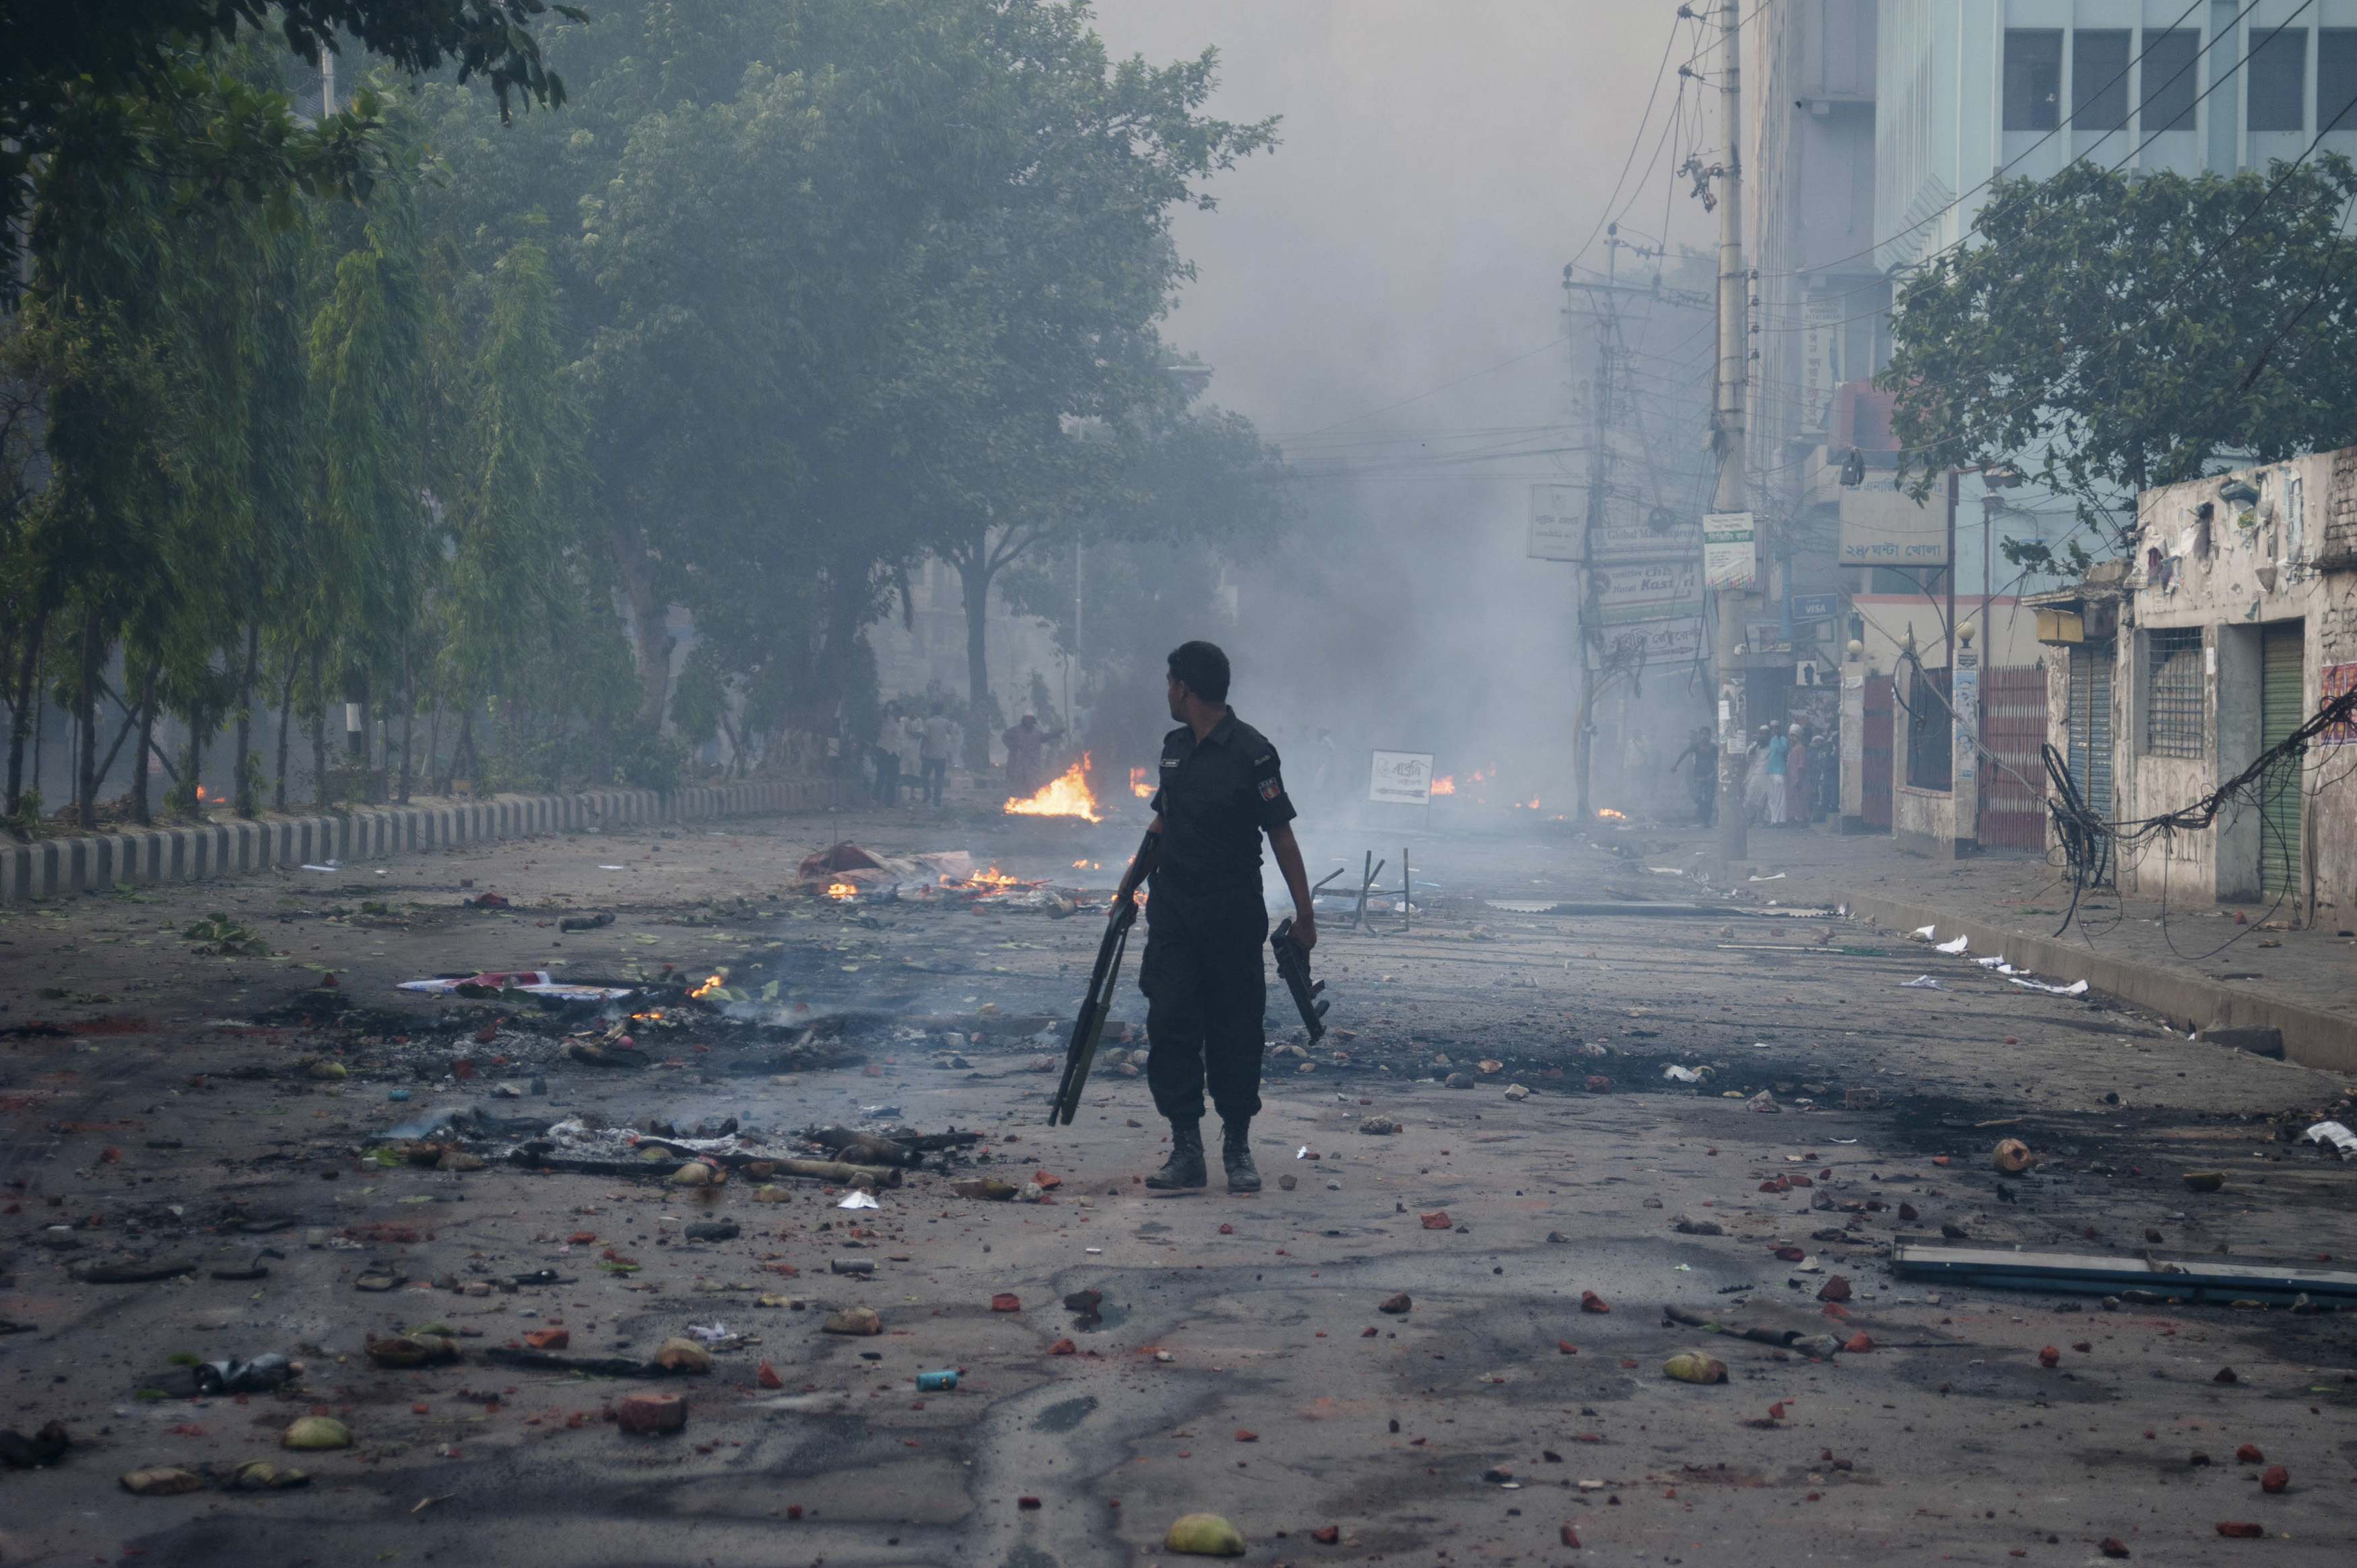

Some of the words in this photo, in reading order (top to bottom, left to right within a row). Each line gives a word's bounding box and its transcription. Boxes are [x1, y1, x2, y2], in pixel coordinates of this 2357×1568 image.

[1607, 529, 1637, 540] Global
[1846, 545, 1865, 557] ২৪
[1871, 542, 1899, 556] ঘন্টা
[1905, 544, 1941, 556] খোলা
[1613, 584, 1636, 594] Hotel
[1640, 575, 1695, 591] Kastri
[1805, 604, 1826, 614] VISA
